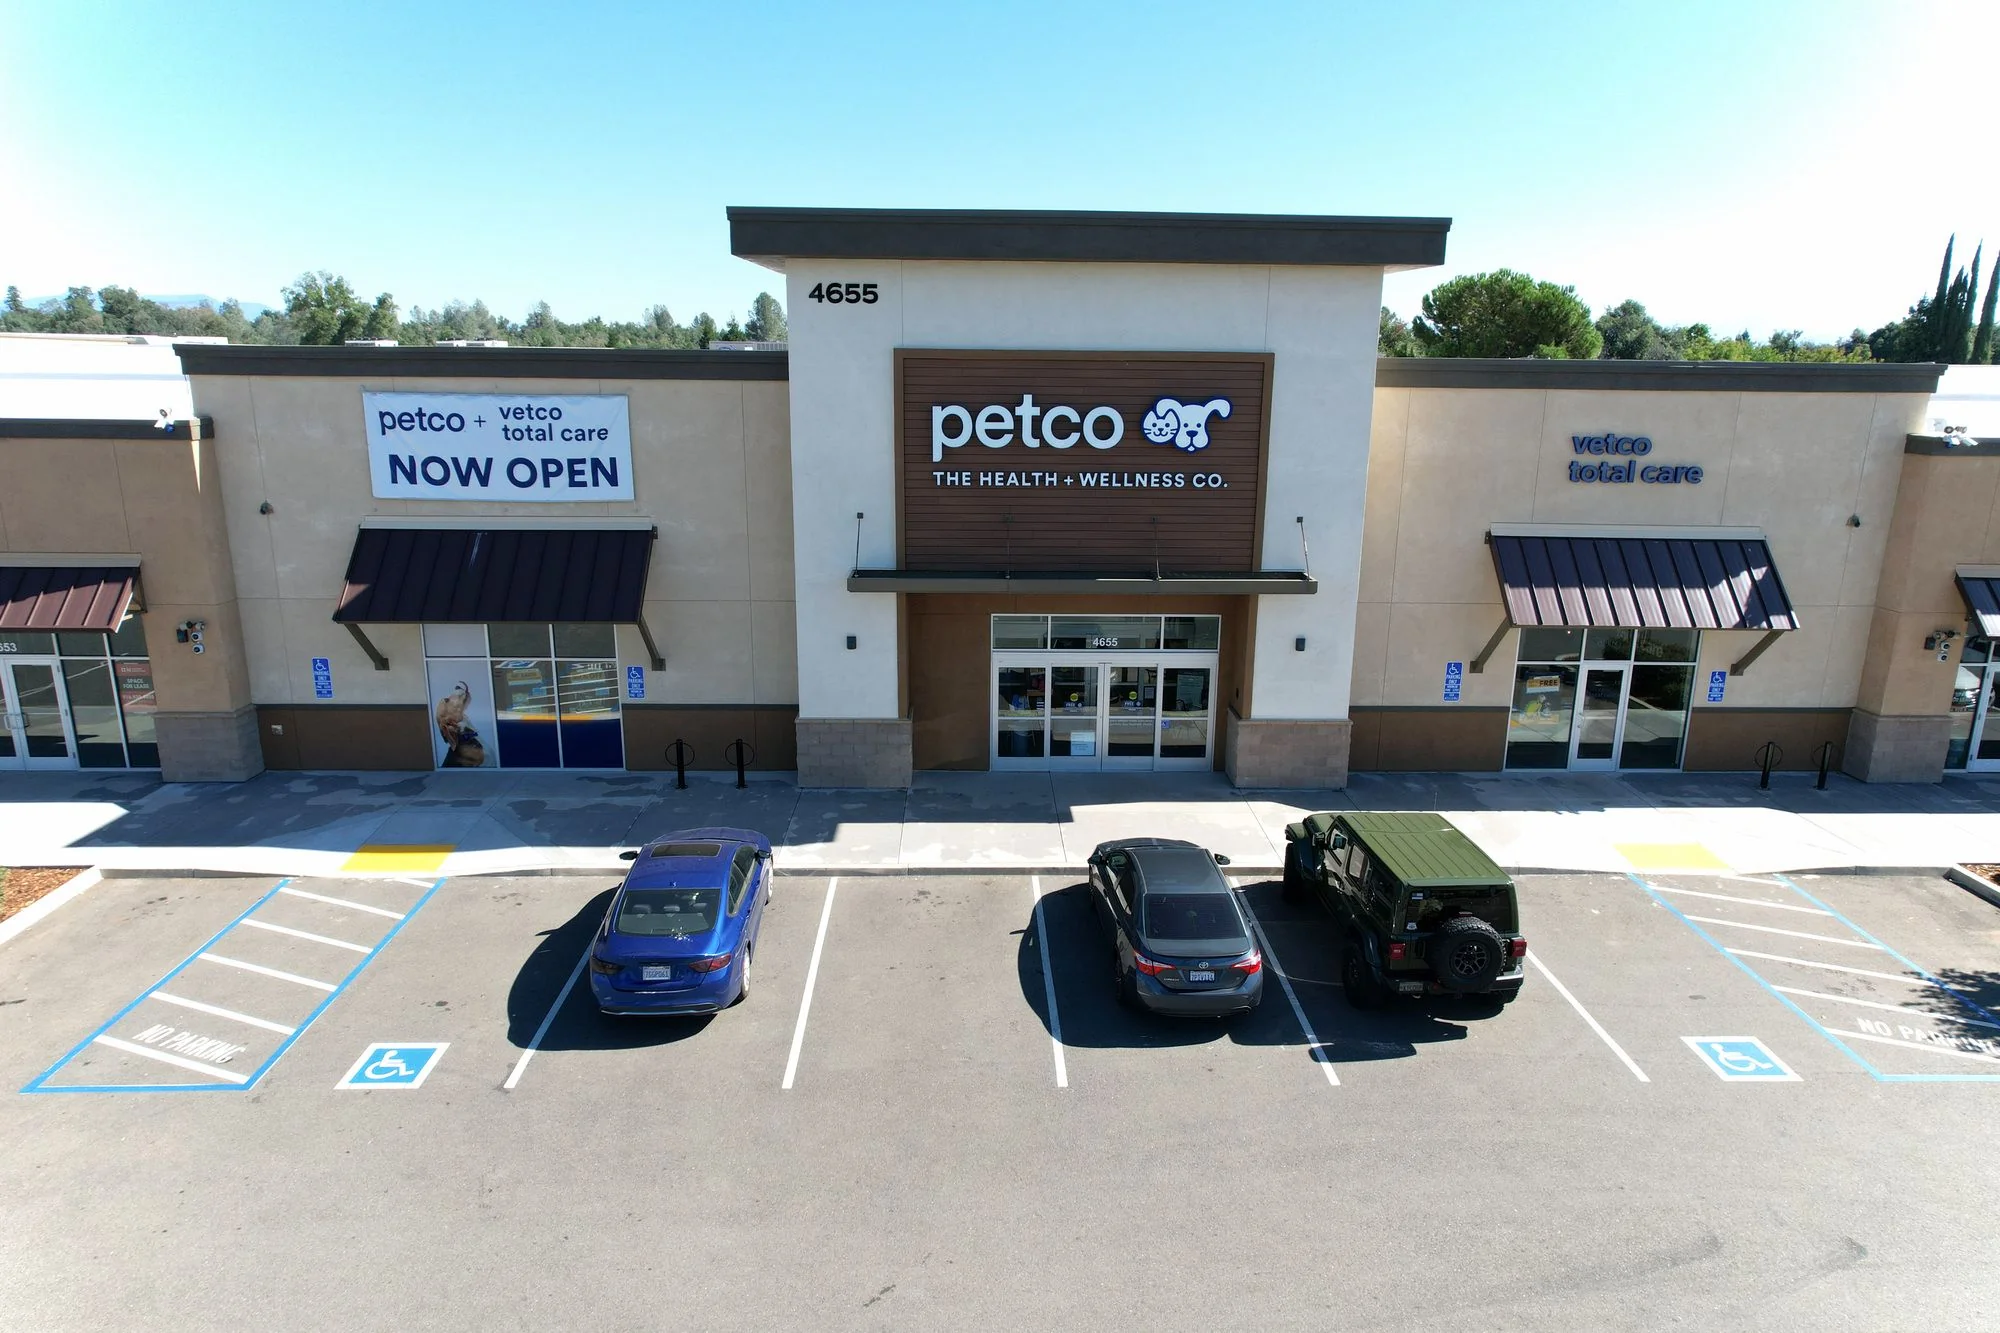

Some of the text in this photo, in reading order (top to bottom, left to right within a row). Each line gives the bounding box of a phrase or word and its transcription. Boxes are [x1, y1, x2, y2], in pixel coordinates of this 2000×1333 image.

[809, 282, 879, 304] 4655
[378, 407, 465, 435] petco
[499, 404, 562, 420] vetco
[502, 423, 609, 441] total care
[931, 394, 1125, 463] petco
[1571, 433, 1652, 456] vetco
[388, 454, 619, 488] NOW OPEN
[933, 471, 972, 486] THE
[979, 472, 1058, 487] HEALTH
[1079, 472, 1185, 488] WELLNESS
[1192, 473, 1228, 488] CO.
[1569, 460, 1703, 484] total care
[1092, 637, 1118, 647] 4655
[1539, 679, 1558, 687] FREE
[1856, 1017, 1893, 1036] NO
[132, 1023, 246, 1064] NO PARKING
